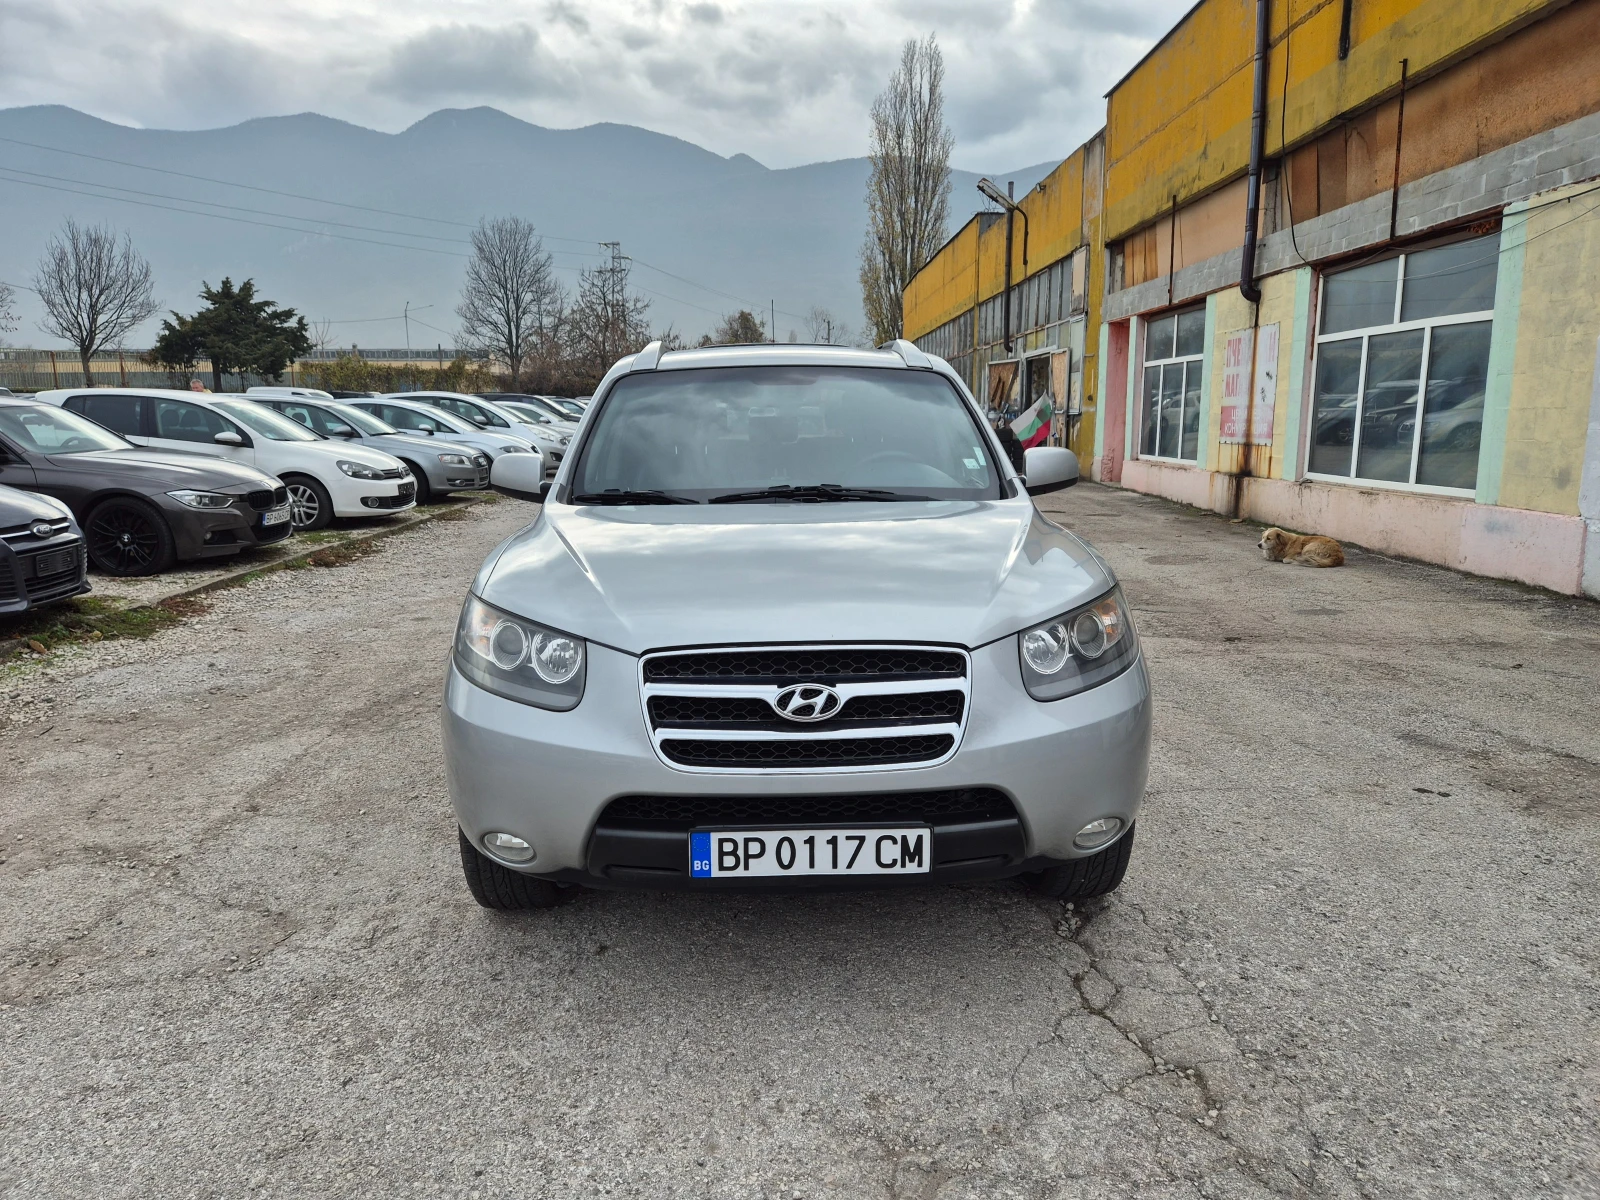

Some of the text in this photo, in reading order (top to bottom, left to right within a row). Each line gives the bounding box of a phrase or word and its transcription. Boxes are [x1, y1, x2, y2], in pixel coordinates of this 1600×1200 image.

[717, 834, 923, 871] BP 0117 CM
[693, 860, 710, 871] BG
